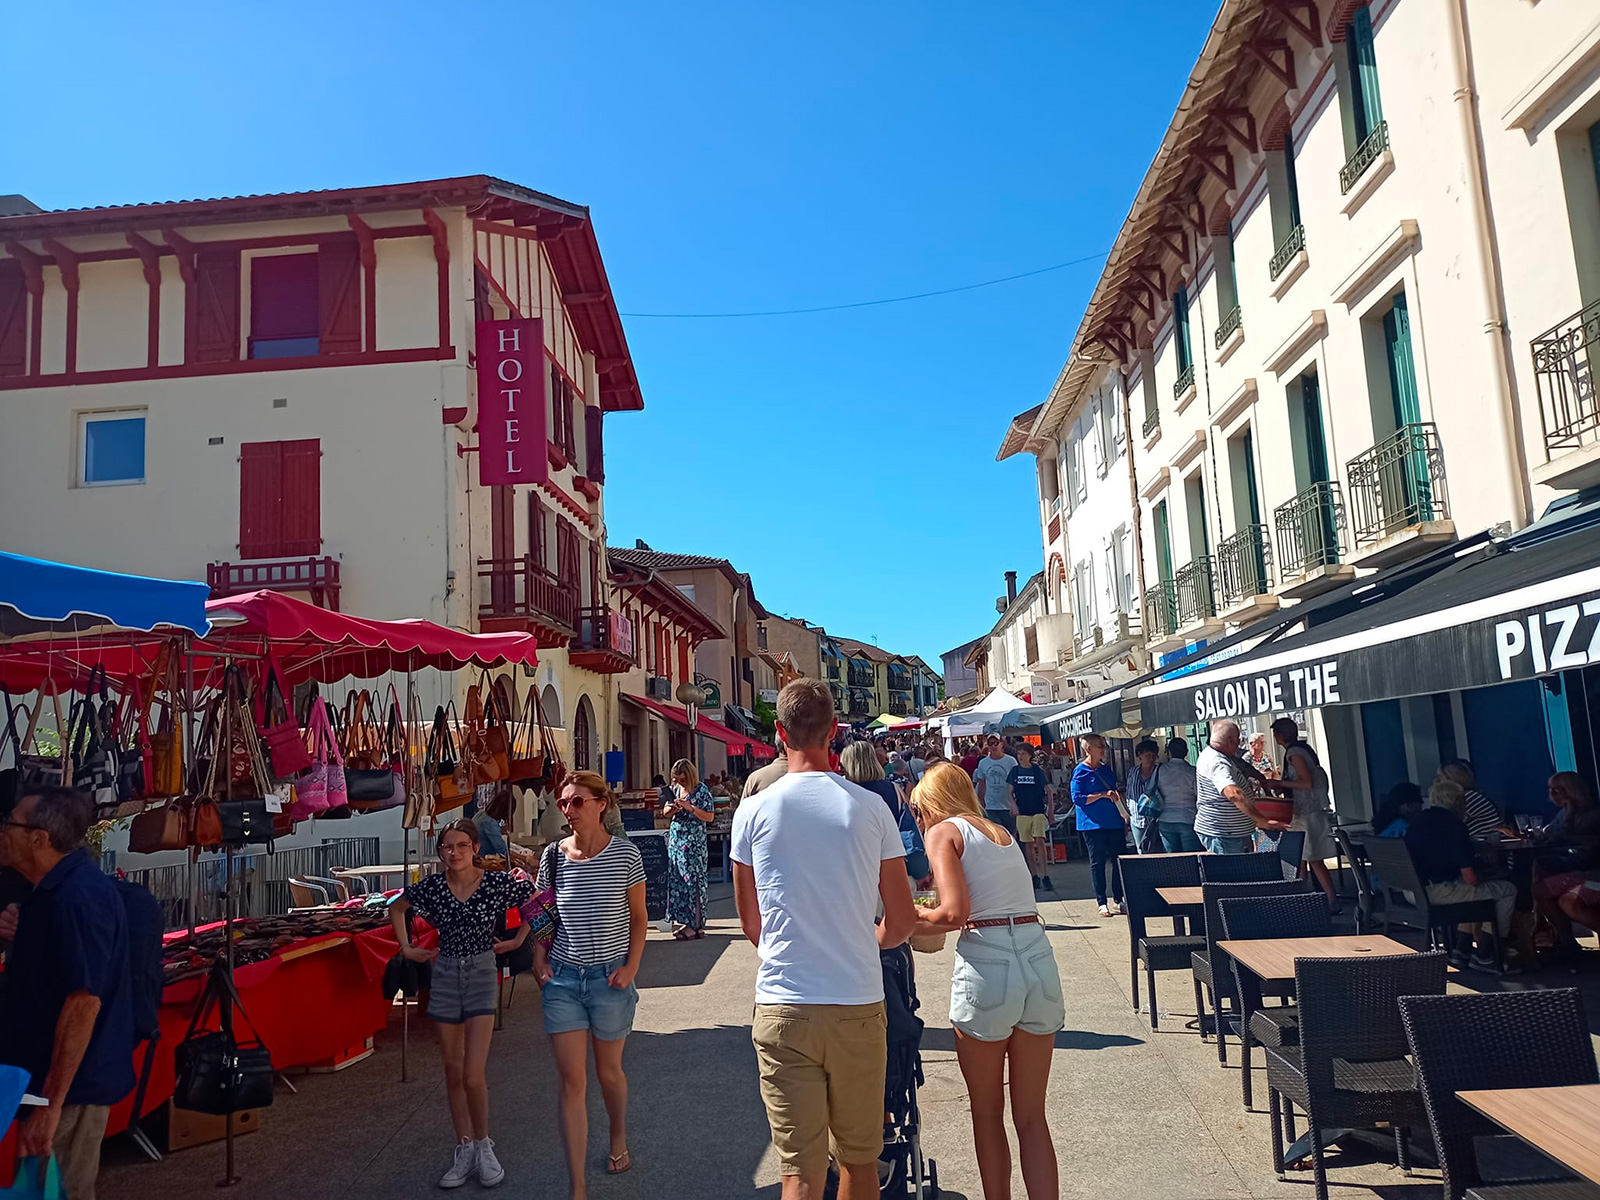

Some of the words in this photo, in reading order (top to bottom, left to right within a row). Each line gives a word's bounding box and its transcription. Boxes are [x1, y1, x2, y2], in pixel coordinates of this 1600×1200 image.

[497, 328, 523, 474] HOTEL
[1194, 679, 1250, 721] SALON
[1255, 673, 1285, 714] DE
[1288, 661, 1341, 708] THE
